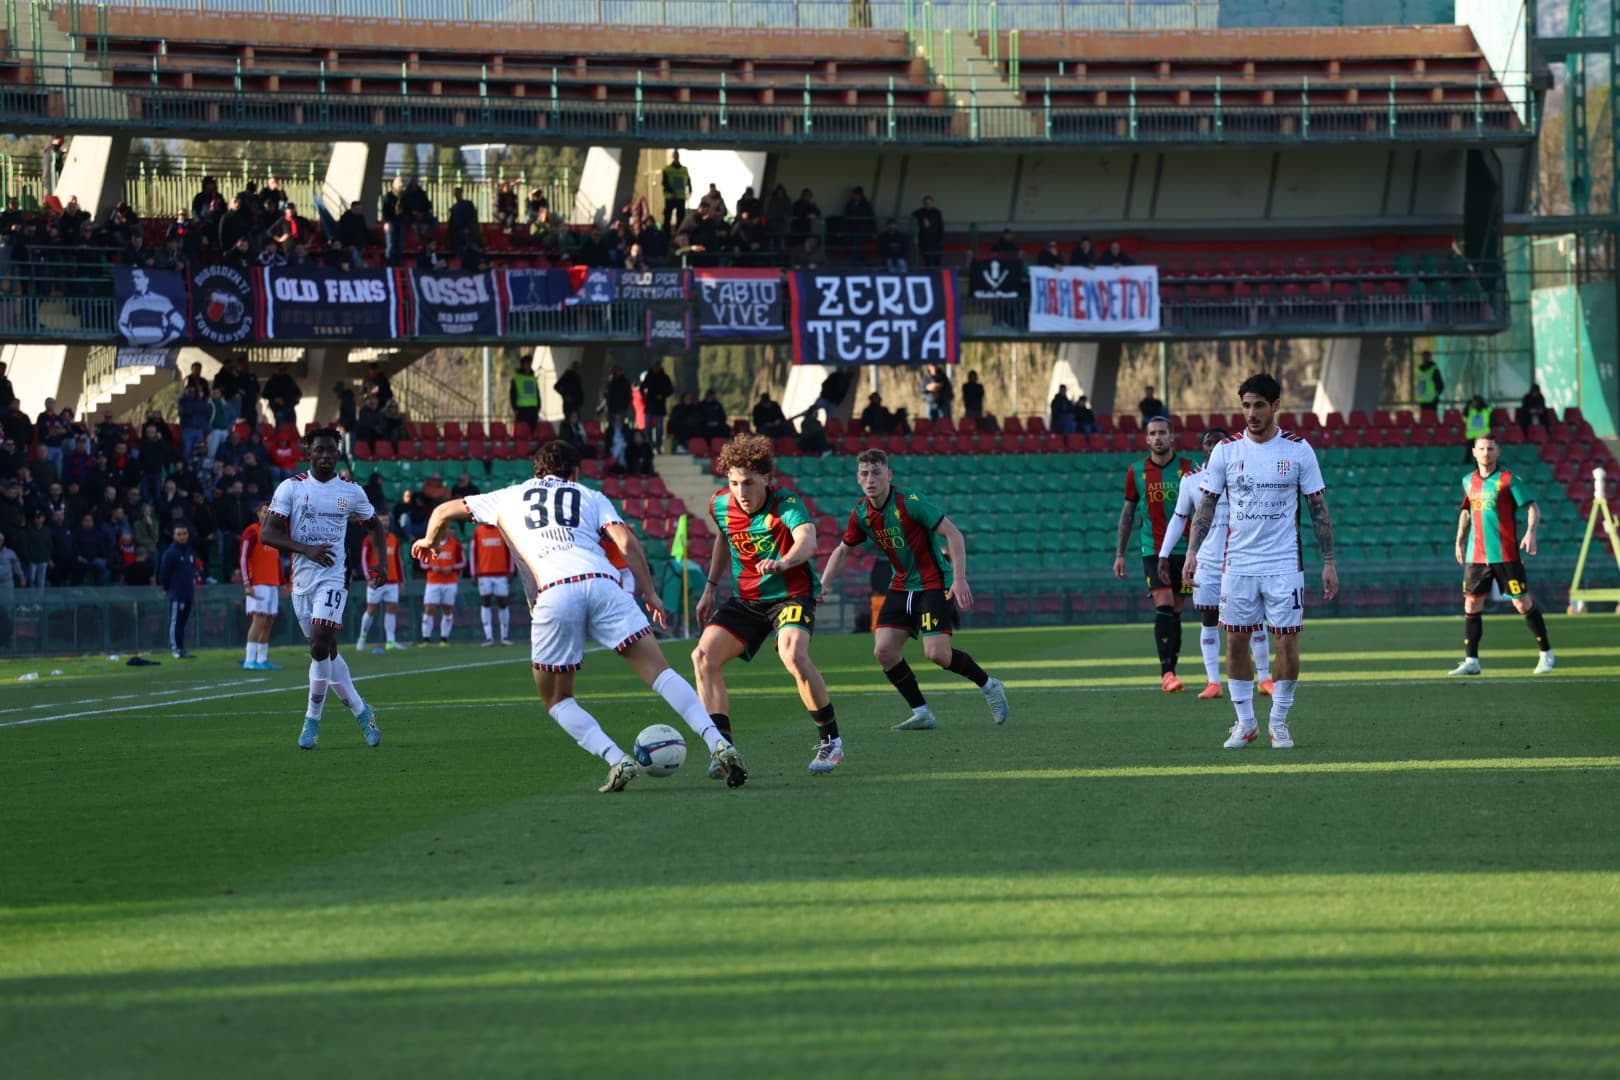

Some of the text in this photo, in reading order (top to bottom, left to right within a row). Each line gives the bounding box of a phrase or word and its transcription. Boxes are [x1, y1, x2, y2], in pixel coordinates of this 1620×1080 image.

[274, 277, 387, 303] OLD FANS
[419, 273, 490, 306] OSSI
[621, 272, 653, 286] SOLO
[700, 277, 777, 303] FABIO
[815, 276, 934, 316] ZERO
[711, 303, 769, 326] VIVE
[806, 319, 946, 361] TESTA
[523, 487, 581, 530] 30
[324, 589, 342, 610] 19
[921, 612, 932, 631] 4
